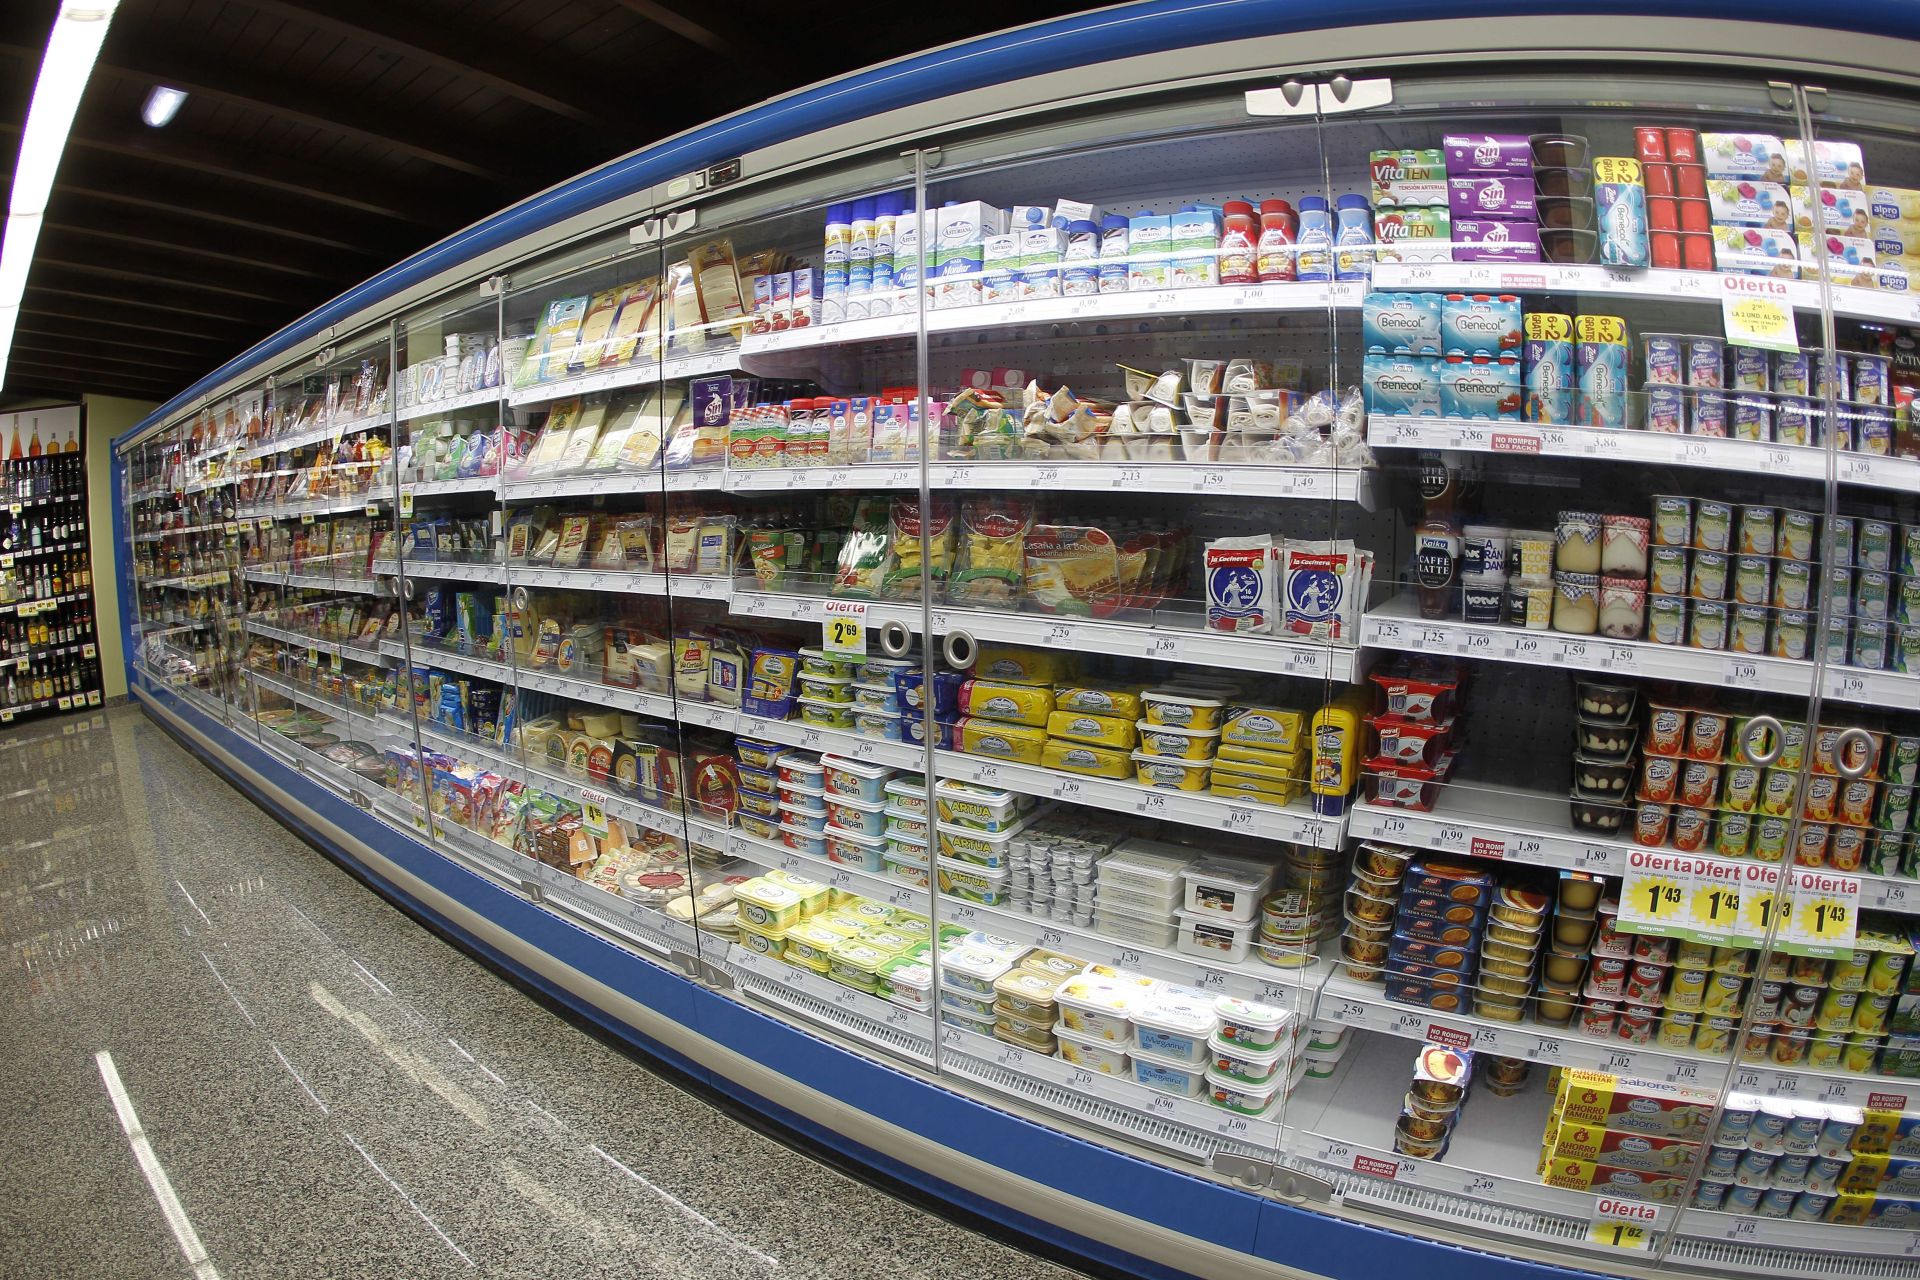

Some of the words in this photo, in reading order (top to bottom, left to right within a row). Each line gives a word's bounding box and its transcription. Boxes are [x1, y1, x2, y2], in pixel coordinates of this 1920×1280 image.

[1476, 147, 1498, 158] Sin
[1602, 159, 1614, 182] GRATIS
[1617, 160, 1632, 183] 6+2
[1482, 188, 1503, 199] Sin
[1874, 205, 1897, 216] alpro
[1457, 223, 1477, 231] Kaiku
[1877, 242, 1901, 253] alpro
[1724, 277, 1787, 295] Oferta
[1881, 276, 1905, 287] alpro
[1382, 317, 1422, 328] Benecol
[1461, 319, 1501, 330] Benecol
[1532, 315, 1542, 340] GRATIS
[1545, 316, 1561, 341] 6+2
[1585, 317, 1595, 341] GRATIS
[1598, 318, 1615, 343] 6+2
[1382, 380, 1422, 391] Benecol
[1459, 382, 1501, 394] Benecol
[707, 403, 722, 415] Sin
[1395, 427, 1418, 437] 3,86
[1460, 430, 1483, 440] 3,86
[1508, 438, 1537, 446] ROMPER
[1542, 433, 1564, 443] 3,86
[1594, 437, 1617, 448] 3,86
[1685, 445, 1707, 456] 1,99
[1769, 453, 1790, 463] 1,99
[1850, 462, 1870, 473] 1,99
[892, 471, 908, 481] 1,19
[952, 470, 970, 480] 2,15
[1039, 471, 1058, 481] 2,69
[1121, 471, 1141, 481] 2,13
[1202, 474, 1223, 485] 1,59
[1292, 477, 1314, 488] 1,49
[1023, 541, 1053, 550] Lasaña
[1422, 538, 1447, 549] Kaiku
[1485, 540, 1493, 548] A
[1485, 549, 1503, 559] RÁN
[1419, 555, 1449, 566] CAFFÈ
[1419, 565, 1449, 575] LATTE
[825, 601, 865, 613] Oferta
[834, 622, 857, 644] 2'69
[1051, 628, 1069, 638] 2,29
[1378, 627, 1399, 637] 1,25
[1423, 631, 1444, 642] 1,25
[1155, 640, 1175, 651] 1,89
[1468, 635, 1490, 647] 1,69
[1515, 639, 1537, 651] 1,69
[1563, 645, 1585, 656] 1,59
[1610, 650, 1633, 661] 1,59
[1294, 654, 1316, 666] 0,90
[1735, 667, 1756, 678] 1,99
[1388, 685, 1406, 694] Royal
[1843, 679, 1864, 690] 1,99
[1390, 696, 1406, 710] 10
[806, 733, 819, 743] 1,95
[1381, 728, 1399, 737] Royal
[858, 744, 873, 754] 1,99
[1382, 738, 1398, 751] 10
[980, 766, 997, 777] 3,65
[832, 781, 860, 795] Tulipán
[1062, 782, 1080, 793] 1,89
[581, 789, 605, 803] Oferta
[1146, 796, 1165, 808] 1,95
[951, 802, 992, 818] ARTUA
[836, 815, 864, 830] Tulipán
[1231, 812, 1252, 824] 0,97
[1384, 820, 1405, 831] 1,19
[1441, 830, 1463, 841] 0,99
[953, 836, 993, 852] ARTUA
[1518, 841, 1540, 851] 1,89
[835, 848, 863, 863] Tulipán
[1585, 850, 1607, 861] 1,89
[1630, 852, 1692, 873] Oferta
[1695, 860, 1741, 880] Ofert
[836, 873, 849, 883] 1,99
[951, 871, 989, 888] ARTUA
[1801, 874, 1858, 894] Oferta
[896, 890, 911, 900] 1,55
[1649, 885, 1681, 912] 1'43
[1886, 889, 1905, 900] 1,59
[1709, 892, 1740, 919] 1'43
[746, 907, 765, 921] Flora
[958, 908, 975, 918] 2,99
[1815, 905, 1846, 932] 1'43
[1043, 932, 1061, 944] 0,79
[749, 937, 767, 951] Flora
[1605, 942, 1625, 952] Fresa
[1121, 952, 1140, 963] 1,39
[1204, 973, 1224, 985] 1,85
[1263, 987, 1284, 999] 3,45
[1597, 984, 1618, 993] Fresa
[1342, 1004, 1364, 1015] 2,59
[1755, 1009, 1773, 1018] Coco
[893, 1011, 908, 1022] 2,99
[1400, 1015, 1421, 1028] 0,89
[1587, 1025, 1607, 1034] Fresa
[1442, 1031, 1469, 1042] ROMPER
[1475, 1031, 1496, 1043] 1,55
[1145, 1035, 1185, 1051] Margarina
[1444, 1038, 1467, 1047] PACKS
[1538, 1043, 1559, 1054] 1,95
[1006, 1050, 1022, 1062] 1,79
[1609, 1056, 1630, 1068] 1,02
[1143, 1068, 1182, 1085] Margarina
[1676, 1066, 1697, 1078] 1,02
[1075, 1072, 1092, 1084] 1,19
[1739, 1074, 1759, 1086] 1,02
[1619, 1077, 1677, 1092] Sabores
[1777, 1079, 1796, 1091] 1,02
[1827, 1085, 1847, 1096] 1,02
[1154, 1097, 1173, 1109] 0,90
[1567, 1104, 1606, 1115] AHORRO
[1564, 1110, 1604, 1122] FAMILIAR
[1227, 1118, 1247, 1131] 1,00
[1618, 1116, 1663, 1130] Sabores
[1328, 1145, 1348, 1156] 1,69
[1559, 1141, 1597, 1153] AHORRO
[1557, 1148, 1595, 1159] FAMILIAR
[1369, 1161, 1395, 1170] ROMPER
[1608, 1154, 1655, 1168] Sabores
[1371, 1166, 1393, 1175] PACKS
[1473, 1178, 1494, 1190] 2,49
[1551, 1174, 1588, 1185] AHORRO
[1550, 1181, 1586, 1192] FAMILIAR
[1601, 1187, 1643, 1200] Sabores
[1599, 1200, 1656, 1219] Oferta
[1736, 1223, 1756, 1234] 1,02
